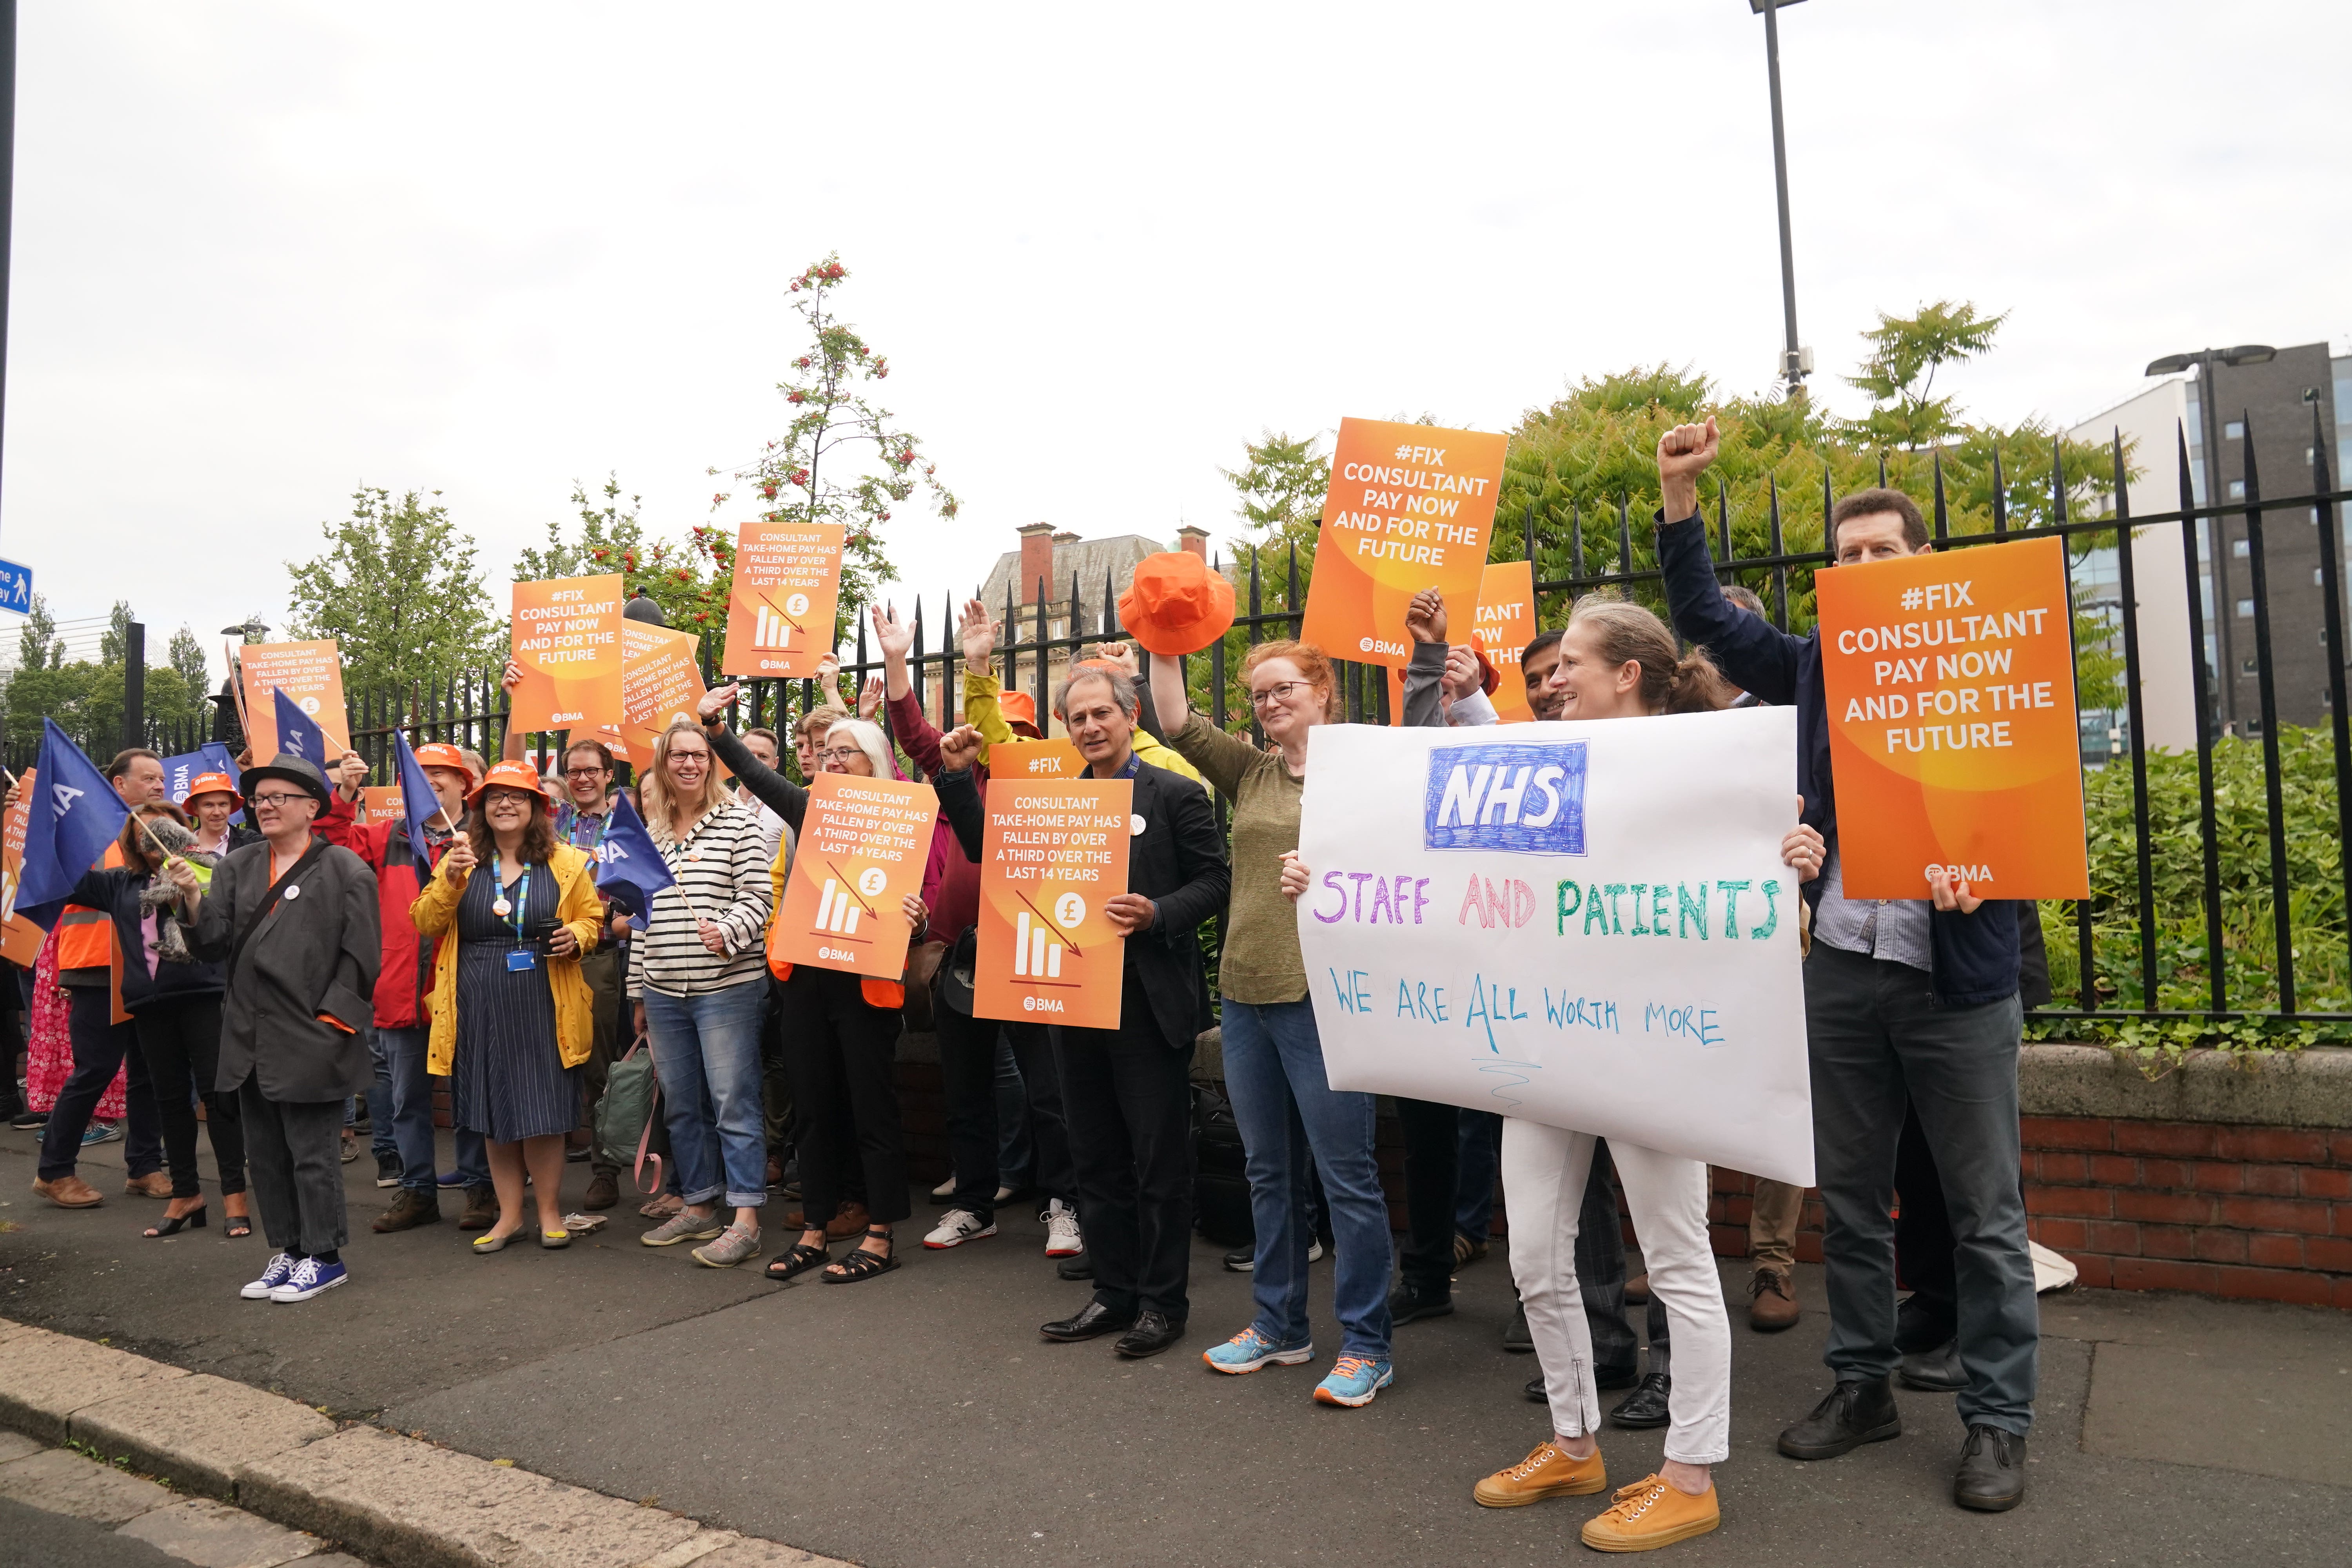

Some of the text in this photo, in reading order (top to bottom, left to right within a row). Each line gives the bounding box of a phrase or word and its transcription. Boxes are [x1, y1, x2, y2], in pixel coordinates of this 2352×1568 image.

[1394, 445, 1446, 467] #FIX
[1344, 462, 1489, 496] CONSULTANT
[1363, 489, 1459, 517] PAY NOW
[1334, 511, 1478, 546] AND FOR THE
[760, 533, 822, 542] CONSULTANT
[742, 544, 837, 554] TAKE-HOME PAY HAS
[1358, 538, 1445, 566] FUTURE
[750, 555, 826, 565] FALLEN BY OVER
[0, 570, 11, 583] ne
[753, 566, 781, 575] THIRD
[783, 566, 809, 575] OVER
[810, 567, 829, 576] THE
[751, 577, 775, 585] LAST
[789, 578, 820, 587] YEARS
[0, 587, 9, 603] ay
[551, 589, 584, 603] #FIX
[1900, 580, 1975, 611] #FIX
[520, 601, 615, 621] CONSULTANT
[536, 618, 599, 634] PAY NOW
[1838, 608, 2048, 655] CONSULTANT
[519, 632, 615, 651] AND FOR THE
[1473, 626, 1503, 644] OW
[623, 639, 653, 652] -HOME
[623, 649, 641, 658] LEN
[1374, 640, 1405, 657] BMA
[261, 649, 317, 659] CONSULTANT
[539, 648, 596, 664] FUTURE
[1486, 646, 1525, 665] THE
[246, 659, 298, 670] TAKE-HOME
[256, 668, 289, 677] FALLEN
[657, 665, 671, 678] PAY
[672, 657, 690, 671] HAS
[769, 661, 790, 670] BMA
[1875, 648, 2012, 686] PAY NOW
[261, 678, 288, 686] THIRD
[289, 675, 312, 684] OVER
[623, 671, 686, 706] FALLEN BY OVER
[262, 687, 284, 695] LAT
[297, 683, 325, 691] YEARS
[624, 679, 693, 717] A THIRD OVER THE
[1844, 681, 2054, 722] AND FOR THE
[632, 692, 690, 724] LAST 14 YEARS
[562, 712, 584, 722] BMA
[285, 729, 304, 758] MA
[1886, 721, 2013, 753] FUTURE
[428, 746, 448, 755] BMA
[613, 743, 628, 755] BM
[500, 765, 522, 774] BMA
[1028, 756, 1062, 773] #FIX
[174, 764, 189, 791] BMA
[837, 788, 912, 806] CONSULTANT
[1014, 797, 1099, 810] CONSULTANT
[1436, 764, 1567, 828] NHS
[371, 809, 405, 817] TAKE-H
[815, 799, 929, 822] TAKE-HOME PAY HAS
[13, 813, 29, 827] FAL
[822, 813, 914, 835] FALLEN BY OVER
[992, 814, 1122, 828] TAKE-HOME PAY HAS
[5, 825, 27, 839] A THI
[813, 827, 916, 849] A THIRD OVER THE
[1003, 831, 1107, 846] FALLEN BY OVER
[6, 837, 23, 852] LAST
[820, 841, 903, 862] LAST 14 YEARS
[996, 849, 1112, 864] A THIRD OVER THE
[1006, 866, 1099, 882] LAST 14 YEARS
[1947, 864, 1994, 883] BMA
[1313, 870, 1782, 940] STAFF AND PATIENTS
[829, 949, 855, 963] BMA
[1036, 998, 1064, 1013] BMA
[1329, 967, 1726, 1054] WE ARE ALL WORTH MORE
